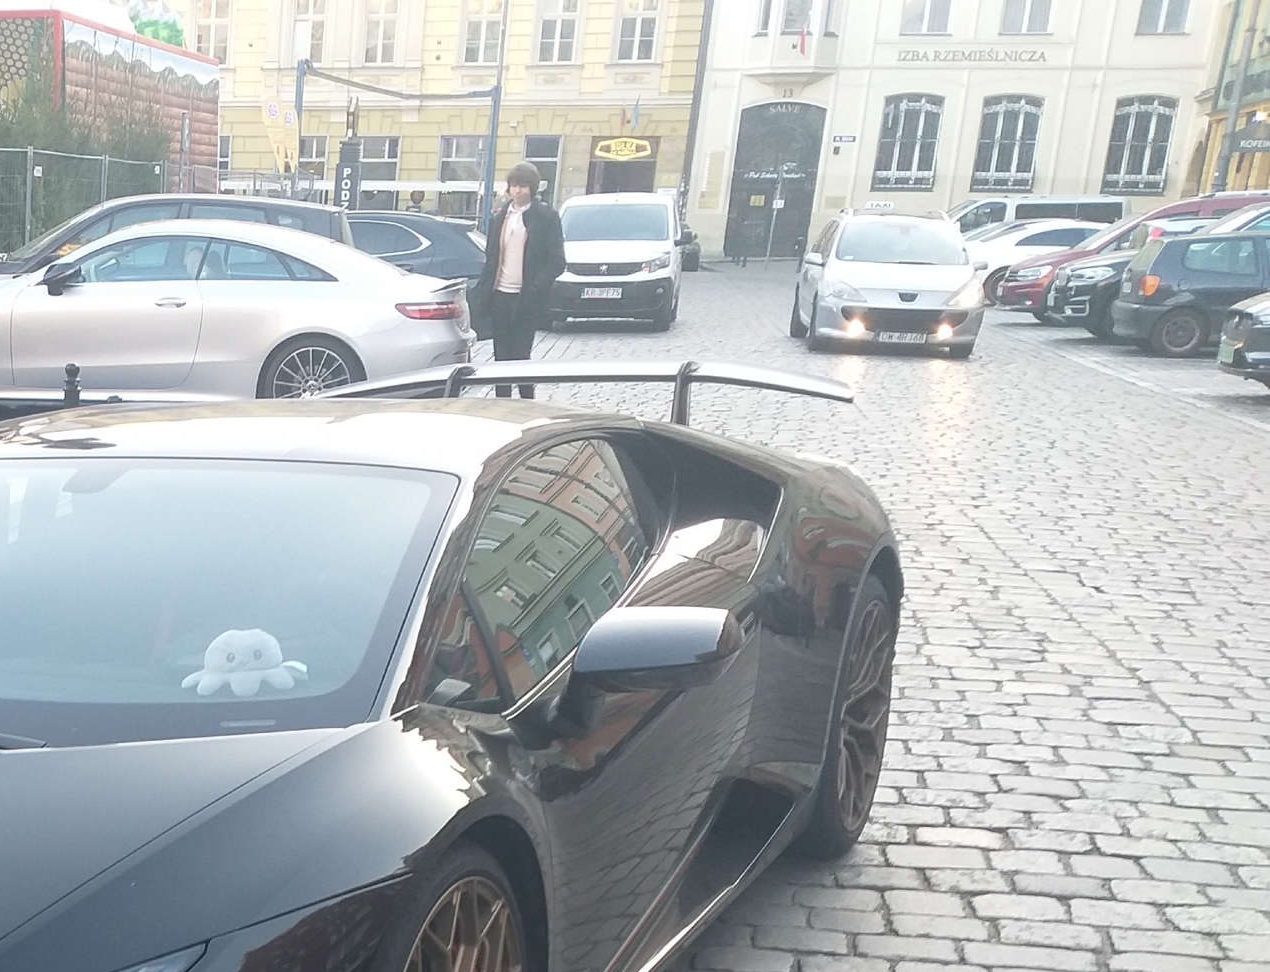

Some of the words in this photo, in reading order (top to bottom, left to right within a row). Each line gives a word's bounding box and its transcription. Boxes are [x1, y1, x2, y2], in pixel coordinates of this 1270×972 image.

[897, 50, 930, 62] IZBA
[932, 47, 1047, 62] RZEMIEŚLNICZA
[782, 88, 793, 98] 13
[769, 104, 801, 113] SALVE
